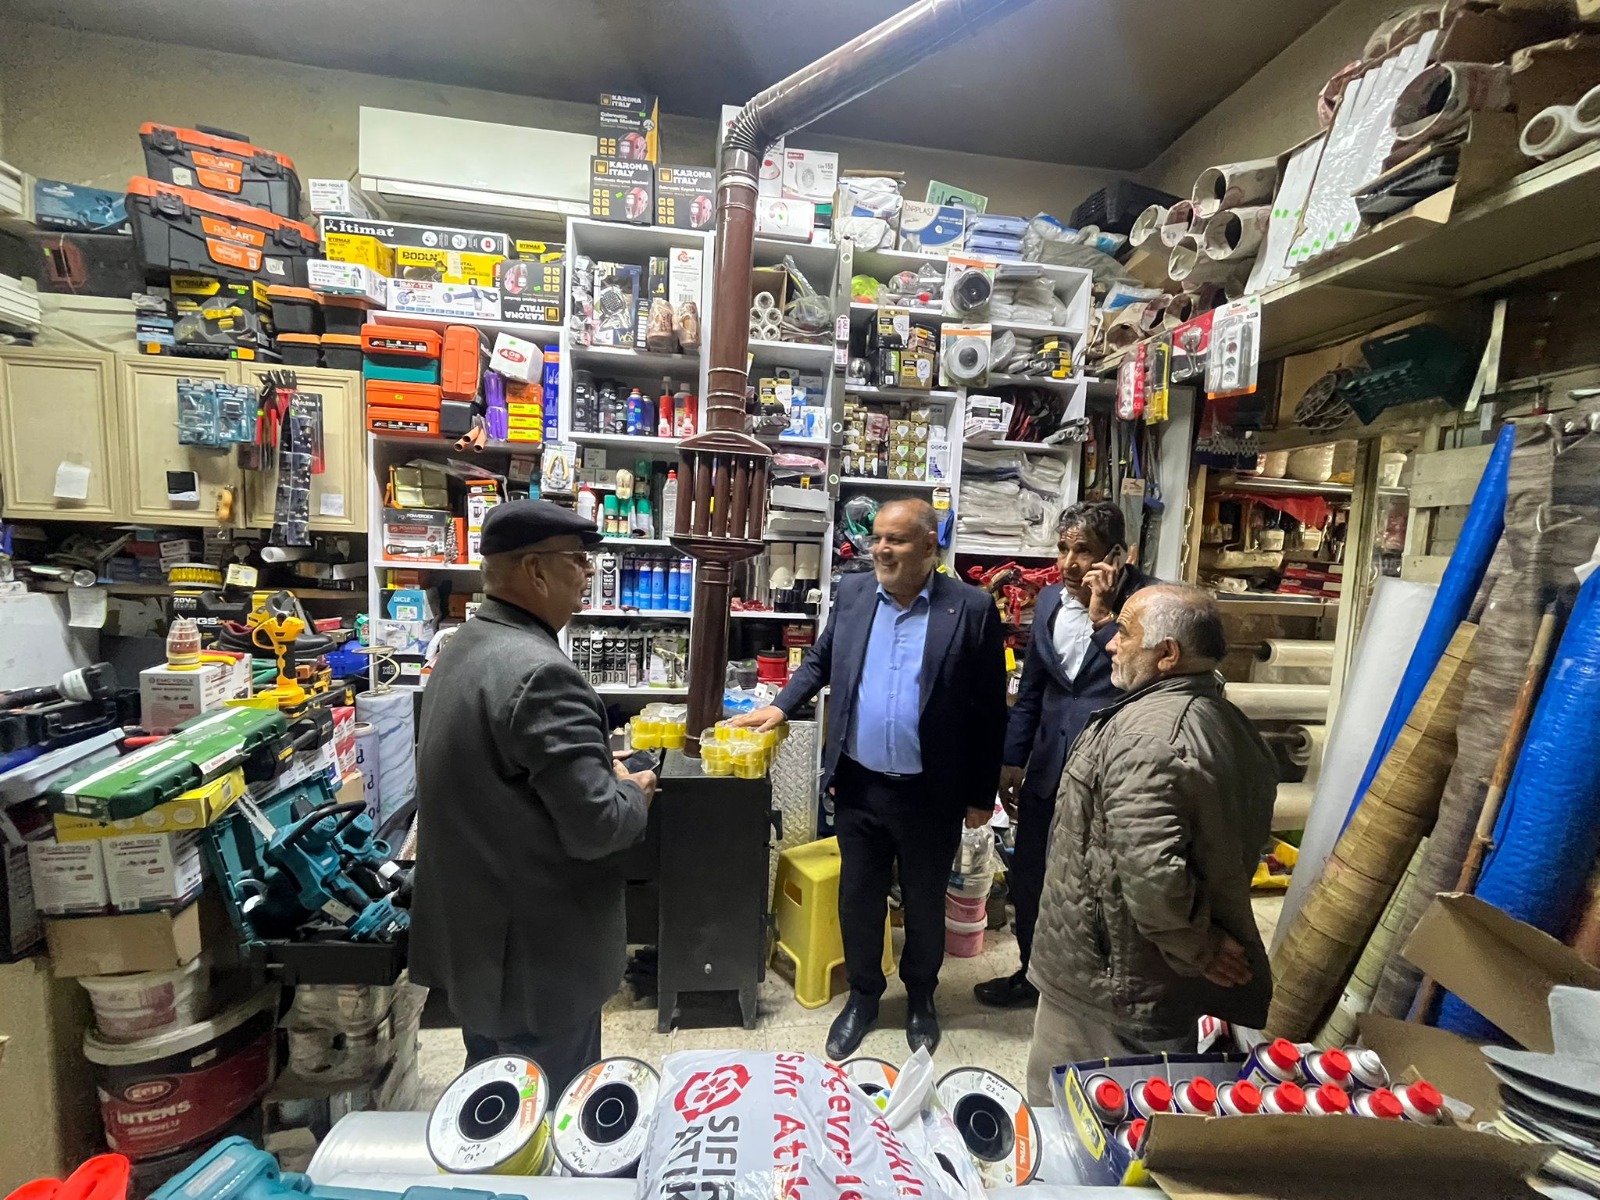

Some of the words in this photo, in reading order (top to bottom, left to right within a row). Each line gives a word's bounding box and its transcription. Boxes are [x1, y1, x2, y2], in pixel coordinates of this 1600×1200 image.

[611, 95, 642, 104] KARONA
[609, 160, 649, 171] KARONA
[609, 169, 634, 177] ITALY
[673, 169, 713, 179] KARONA
[673, 177, 699, 185] ITALY
